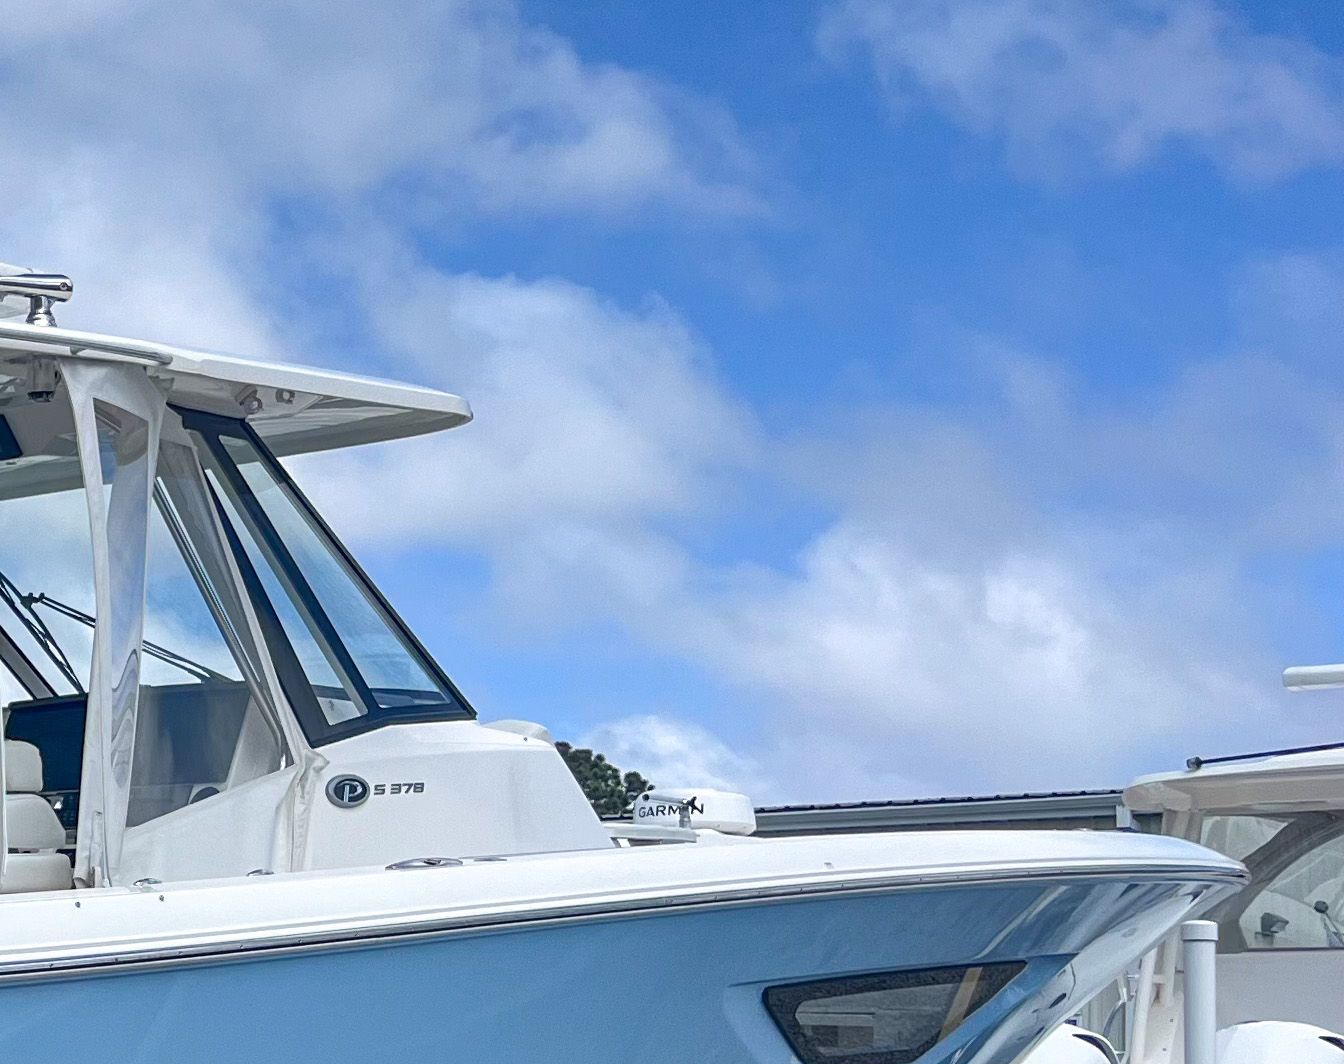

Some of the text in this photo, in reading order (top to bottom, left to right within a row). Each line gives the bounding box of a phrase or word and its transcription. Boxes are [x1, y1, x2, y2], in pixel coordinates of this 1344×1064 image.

[373, 783, 386, 796] S
[390, 782, 425, 795] 378
[638, 802, 704, 818] GARMN
